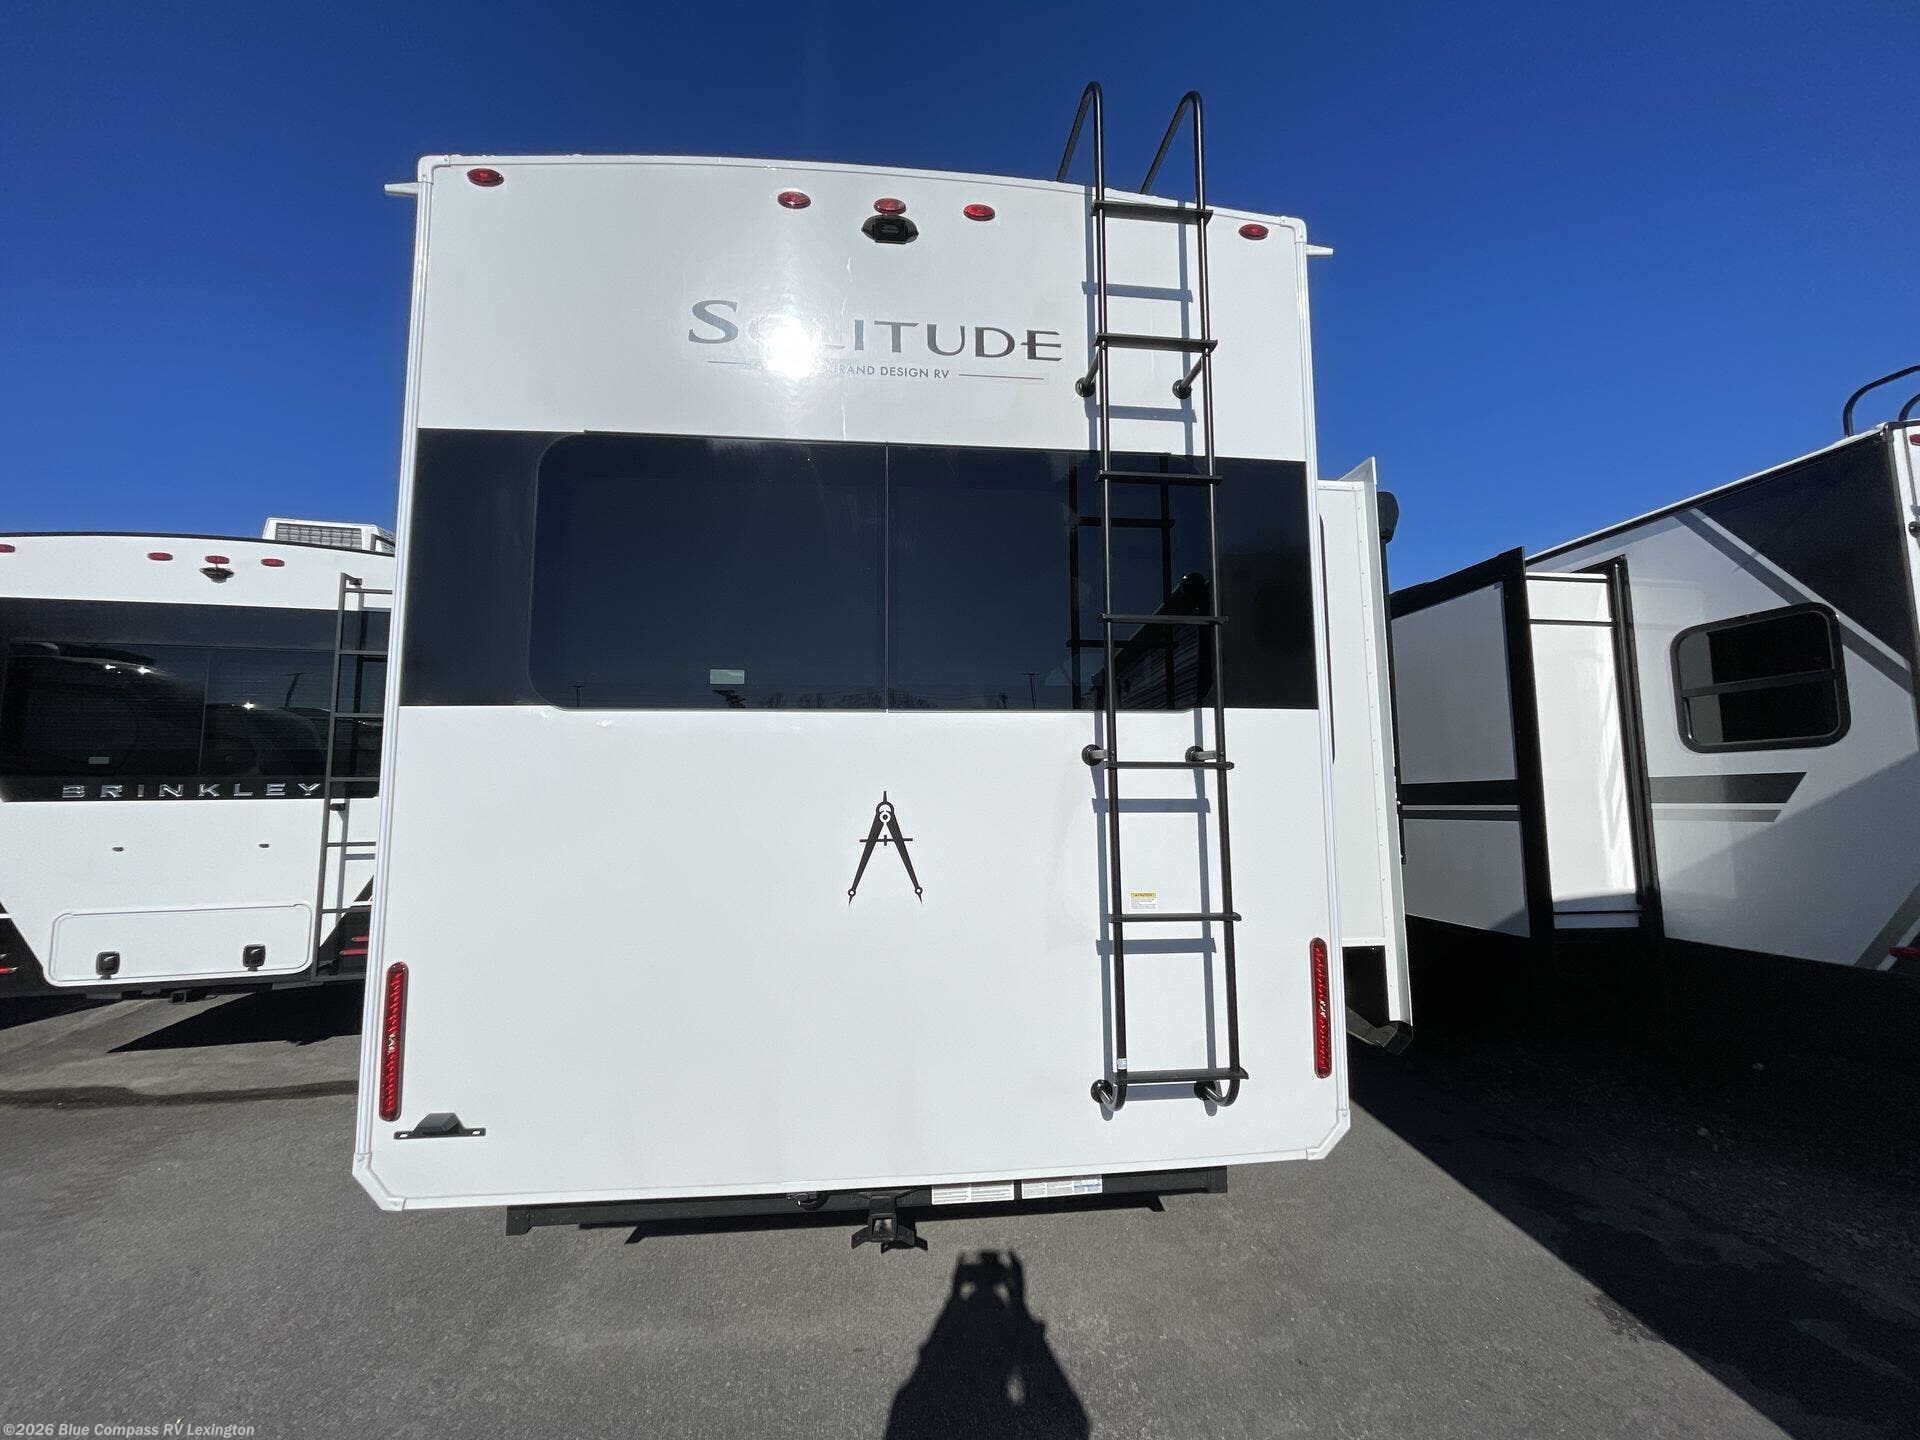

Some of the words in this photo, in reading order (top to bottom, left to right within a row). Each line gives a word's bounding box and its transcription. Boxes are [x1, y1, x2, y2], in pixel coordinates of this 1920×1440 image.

[688, 299, 1063, 362] SITUDE
[829, 364, 875, 376] RAND
[880, 366, 929, 378] DESIGN
[934, 369, 950, 379] RV
[62, 783, 321, 798] BRINKLEY
